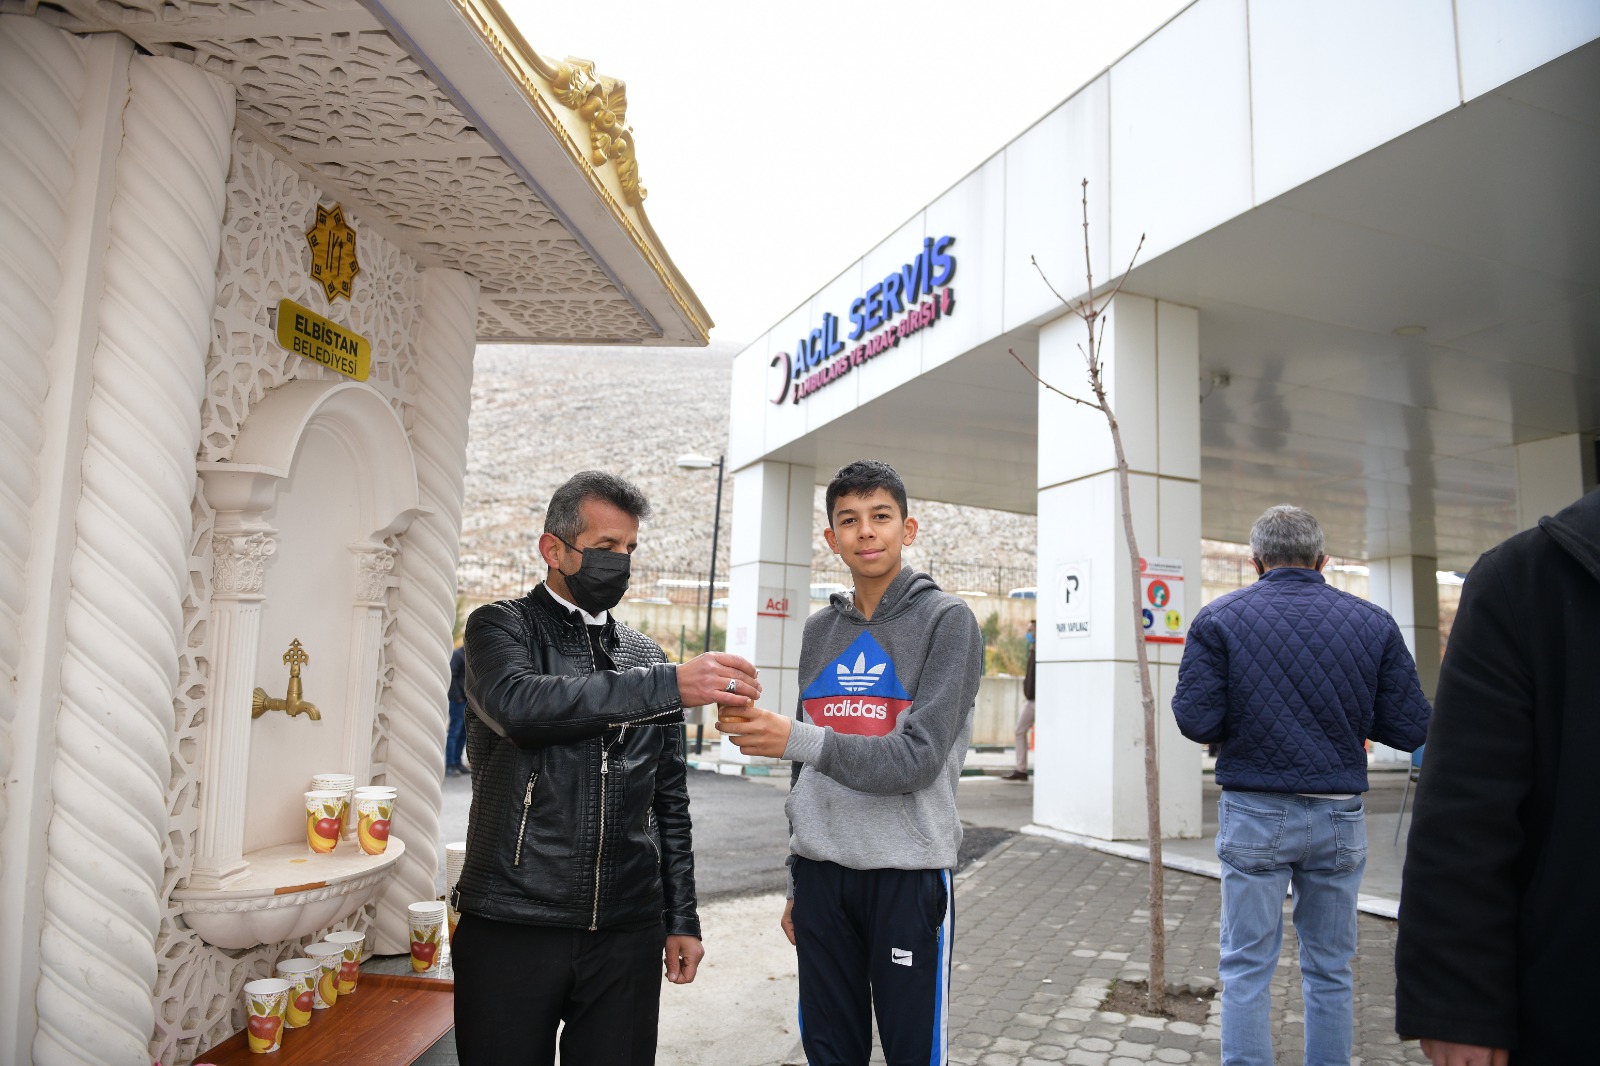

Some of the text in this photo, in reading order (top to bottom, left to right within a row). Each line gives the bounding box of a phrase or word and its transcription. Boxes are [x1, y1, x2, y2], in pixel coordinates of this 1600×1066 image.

[791, 235, 956, 379] ACİL SERVİS
[293, 336, 358, 376] BELEDİYESİ
[294, 313, 359, 357] ELBİSTAN
[796, 294, 940, 400] AMBULANS VE ARAÇ GİRİŞİ
[765, 598, 789, 611] Acil
[823, 700, 887, 720] adidas
